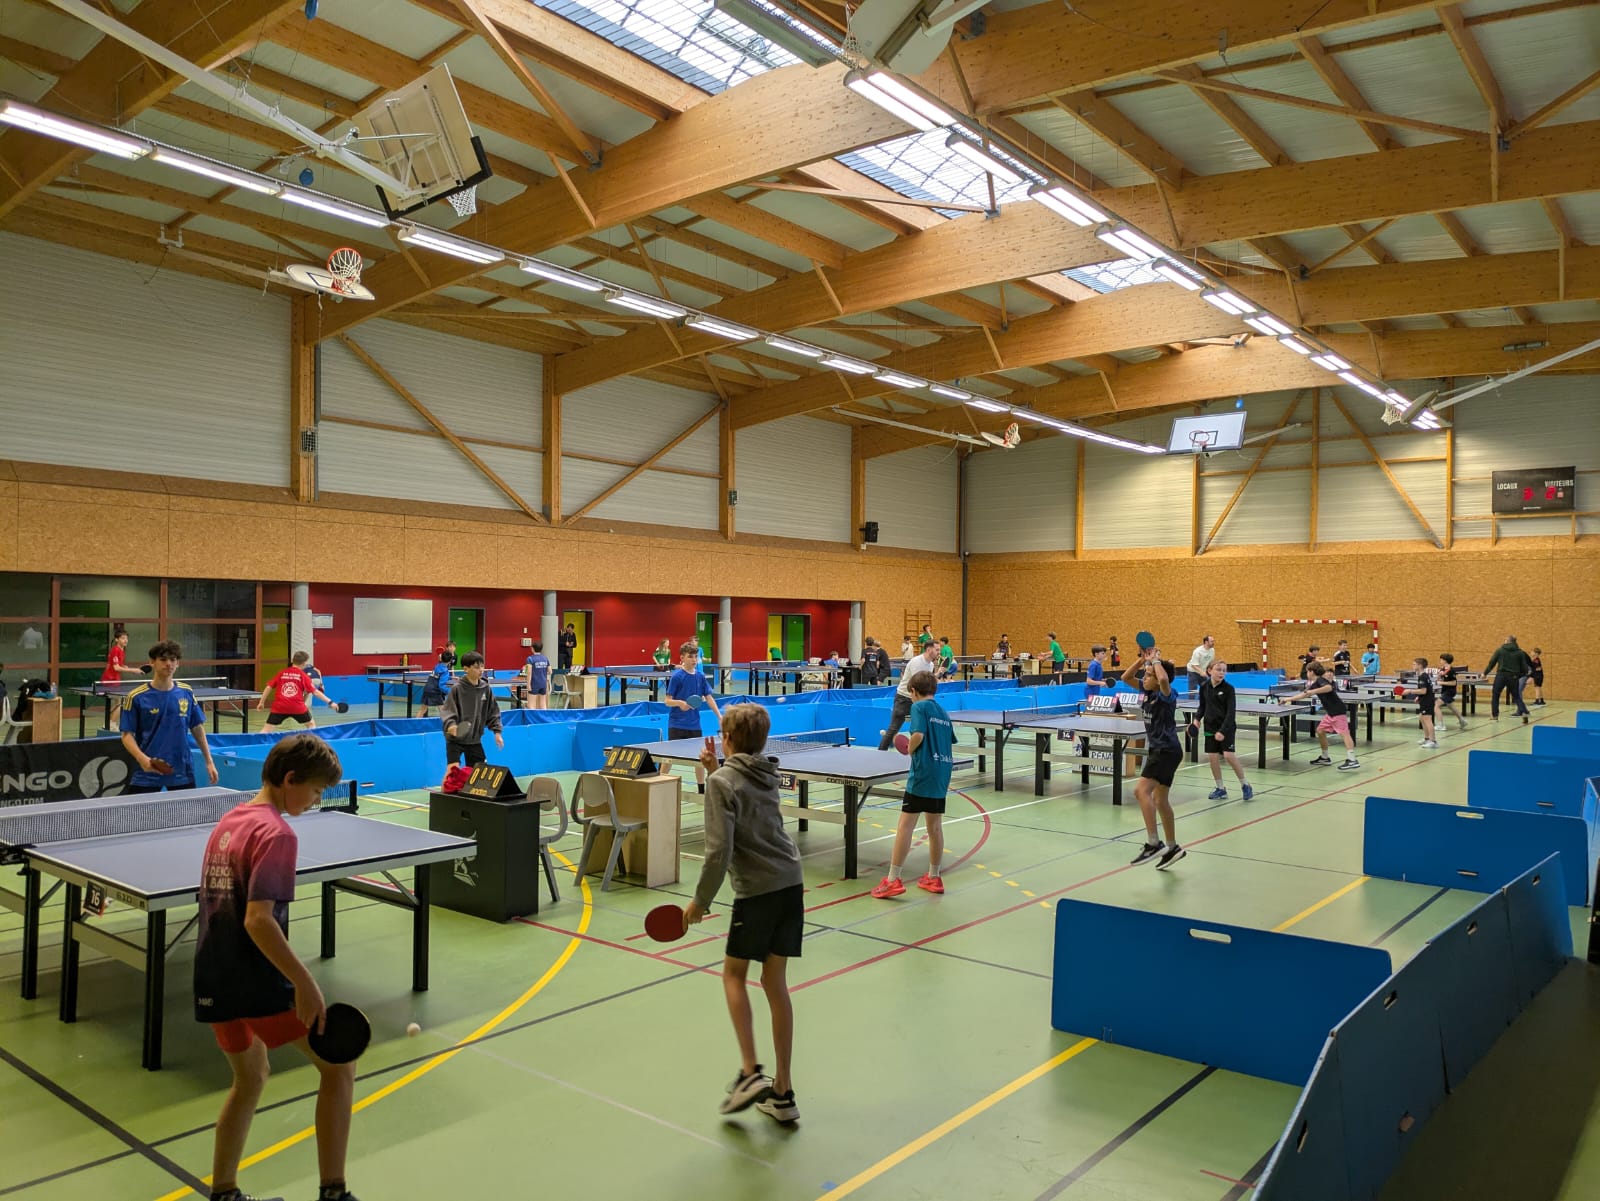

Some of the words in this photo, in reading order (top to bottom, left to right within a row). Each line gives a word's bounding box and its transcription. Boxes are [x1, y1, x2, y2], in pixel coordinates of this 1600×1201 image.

[1496, 482, 1518, 491] LOCAUX
[0, 770, 73, 794] NGO
[782, 776, 791, 786] 15
[91, 889, 100, 907] 16
